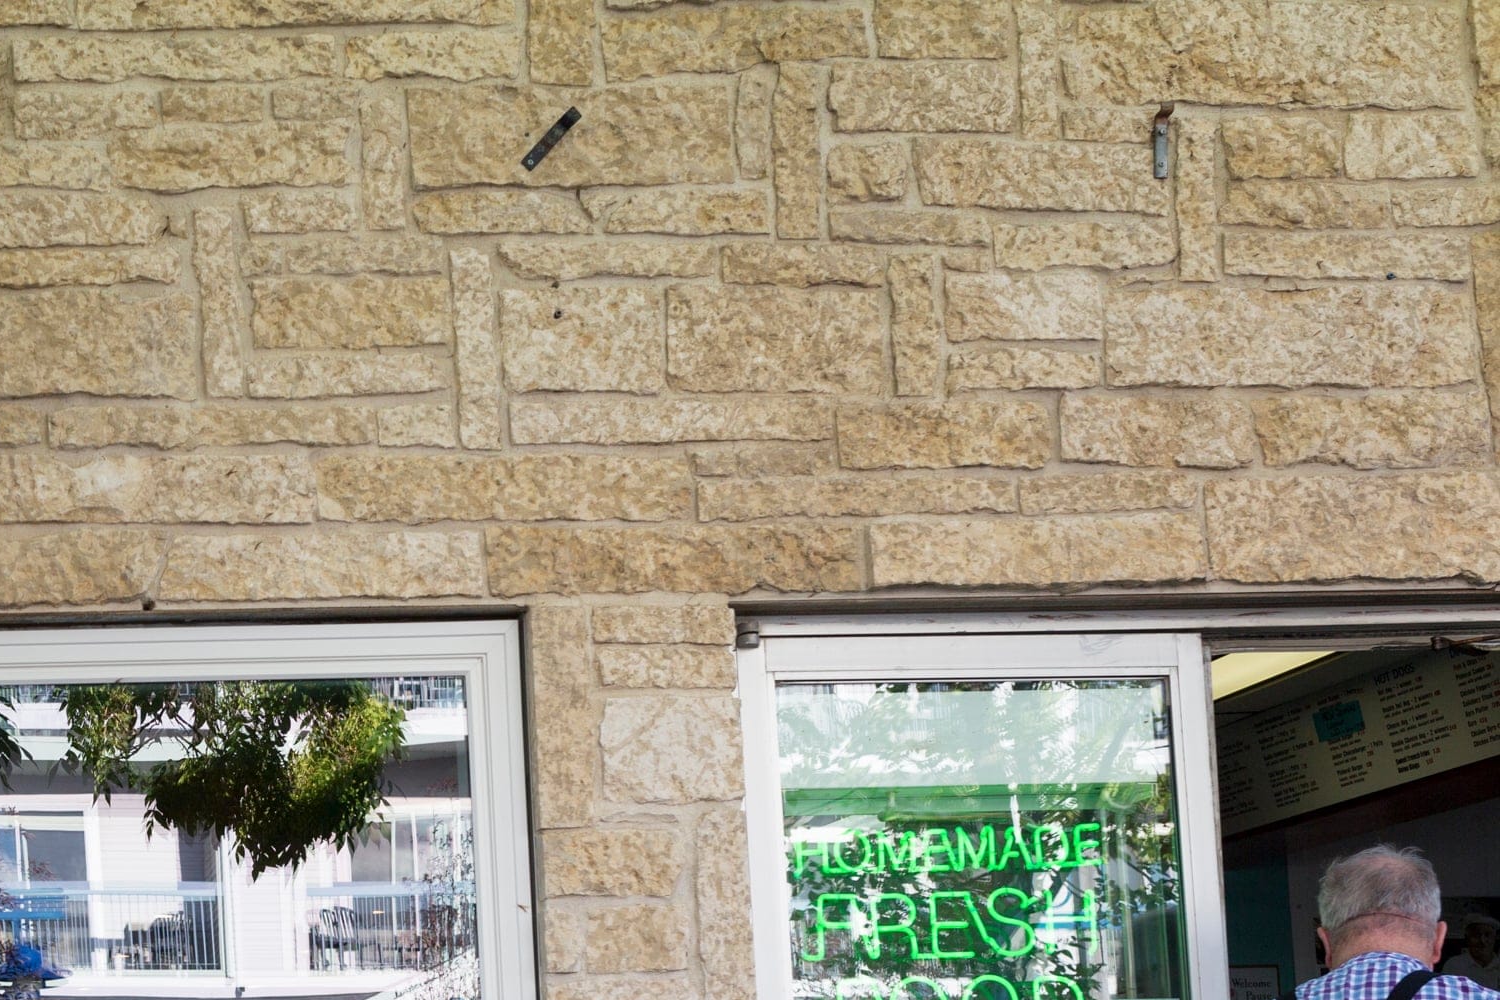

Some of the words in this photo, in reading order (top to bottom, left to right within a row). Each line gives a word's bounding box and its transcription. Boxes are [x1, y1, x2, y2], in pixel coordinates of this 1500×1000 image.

[793, 822, 1102, 879] HOMEMADE
[803, 887, 1099, 961] FRESH
[1231, 978, 1272, 988] Welcome
